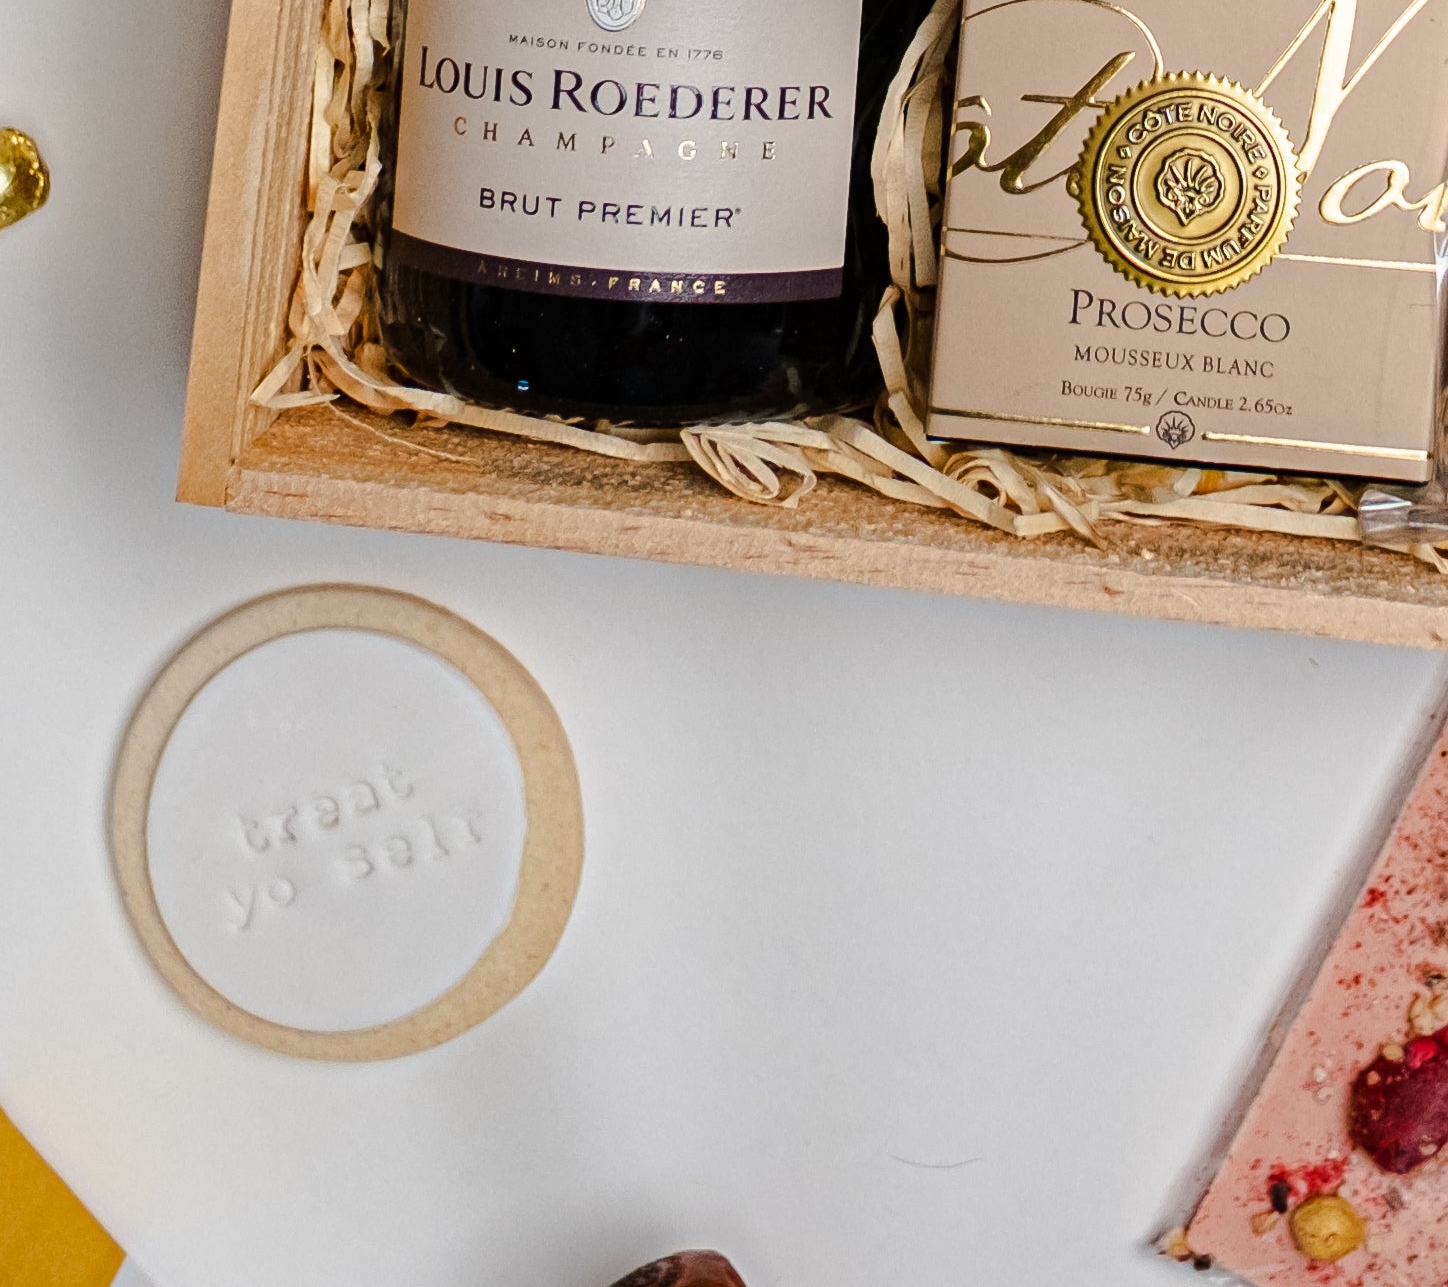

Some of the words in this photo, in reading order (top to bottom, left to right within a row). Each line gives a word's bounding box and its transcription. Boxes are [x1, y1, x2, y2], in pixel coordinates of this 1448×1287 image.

[509, 35, 569, 50] MAISON
[657, 48, 678, 58] EN
[687, 49, 724, 61] 1776
[419, 45, 533, 106] LOUIS
[550, 69, 833, 121] ROEDERER
[454, 116, 776, 161] CHAMPAGNE
[1199, 104, 1266, 164] NOIRE
[480, 187, 562, 218] BRUT
[1107, 164, 1160, 259] MAISON
[1202, 184, 1272, 268] PARFUM
[1162, 251, 1196, 271] DE
[1074, 345, 1195, 371] MOUSSEUX
[1203, 356, 1275, 378] BLANC
[1125, 386, 1152, 406] 75g
